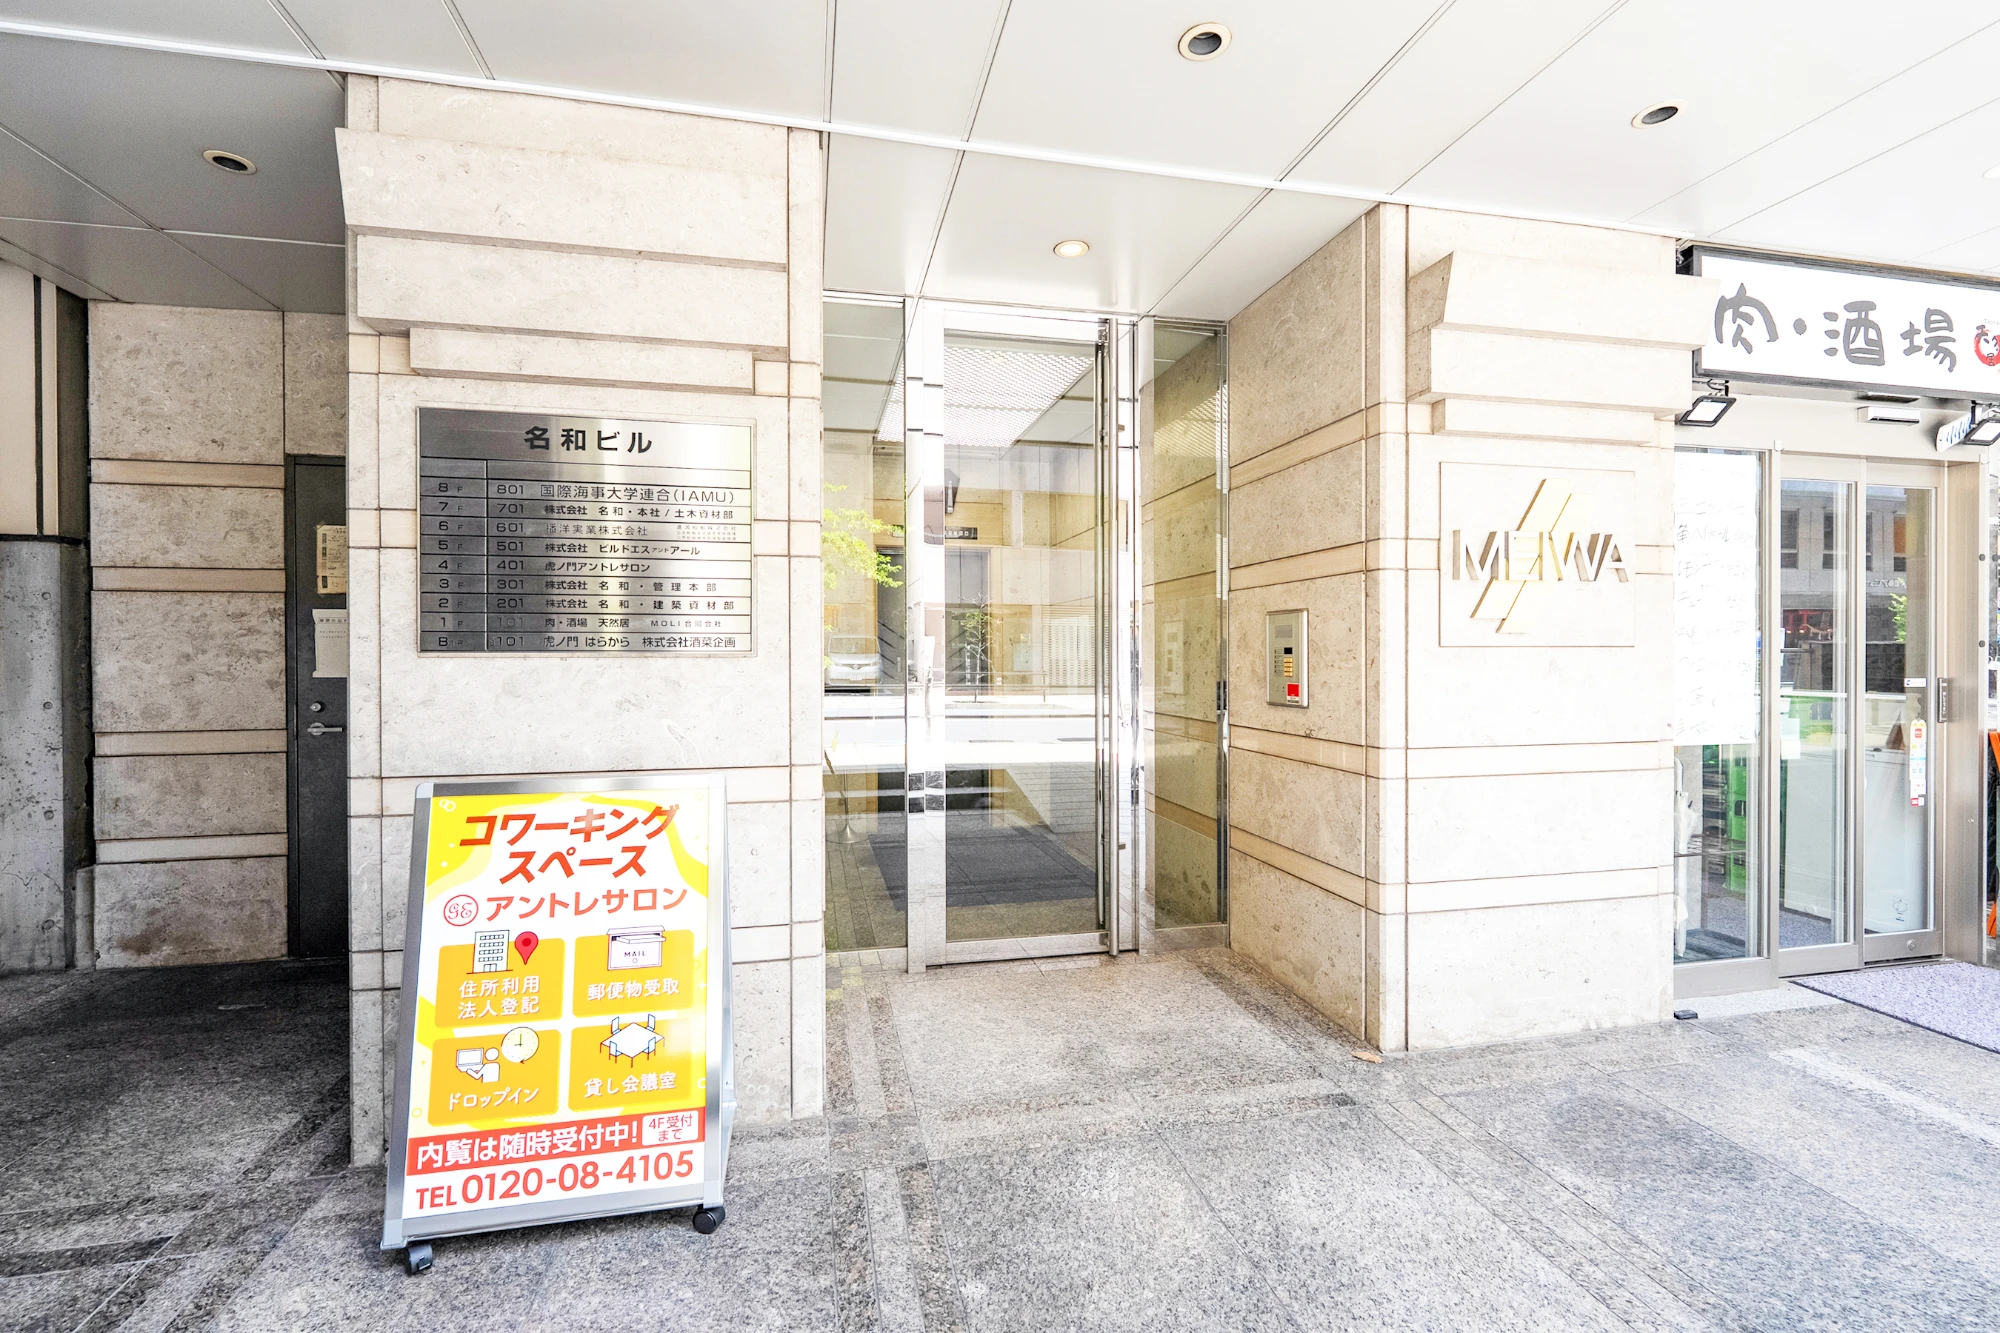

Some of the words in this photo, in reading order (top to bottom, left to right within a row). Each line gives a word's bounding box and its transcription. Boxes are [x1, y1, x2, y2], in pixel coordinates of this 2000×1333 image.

[1714, 282, 1957, 373] 肉・酒場
[523, 425, 653, 454] 名和ビル
[496, 484, 524, 495] 801
[496, 503, 524, 514] 701
[544, 505, 588, 515] 株式会社
[496, 522, 524, 533] 601
[496, 541, 524, 551] 501
[545, 543, 588, 553] 株式会社
[496, 560, 524, 570] 401
[544, 562, 651, 573] 虎ノ門アントレサロン
[496, 579, 524, 590] 301
[545, 580, 588, 590] 株式会社
[496, 598, 524, 609] 201
[545, 598, 588, 609] 株式会社
[544, 617, 588, 628] 肉・酒場
[542, 635, 579, 647] 虎ノ門
[585, 636, 630, 648] はらから
[459, 803, 680, 847] コワーキング
[499, 845, 648, 885] スペース
[486, 887, 688, 922] アントレサロン
[624, 950, 647, 958] MAIL
[458, 974, 540, 999] 住所利用
[587, 976, 680, 1001] 郵便物受取
[458, 995, 540, 1020] 法人登記
[584, 1071, 677, 1098] 貸し会議室
[448, 1086, 539, 1112] ドロップイン
[648, 1113, 693, 1130] 4F受付
[658, 1128, 684, 1142] まで
[461, 1149, 694, 1205] 0120-08-4105
